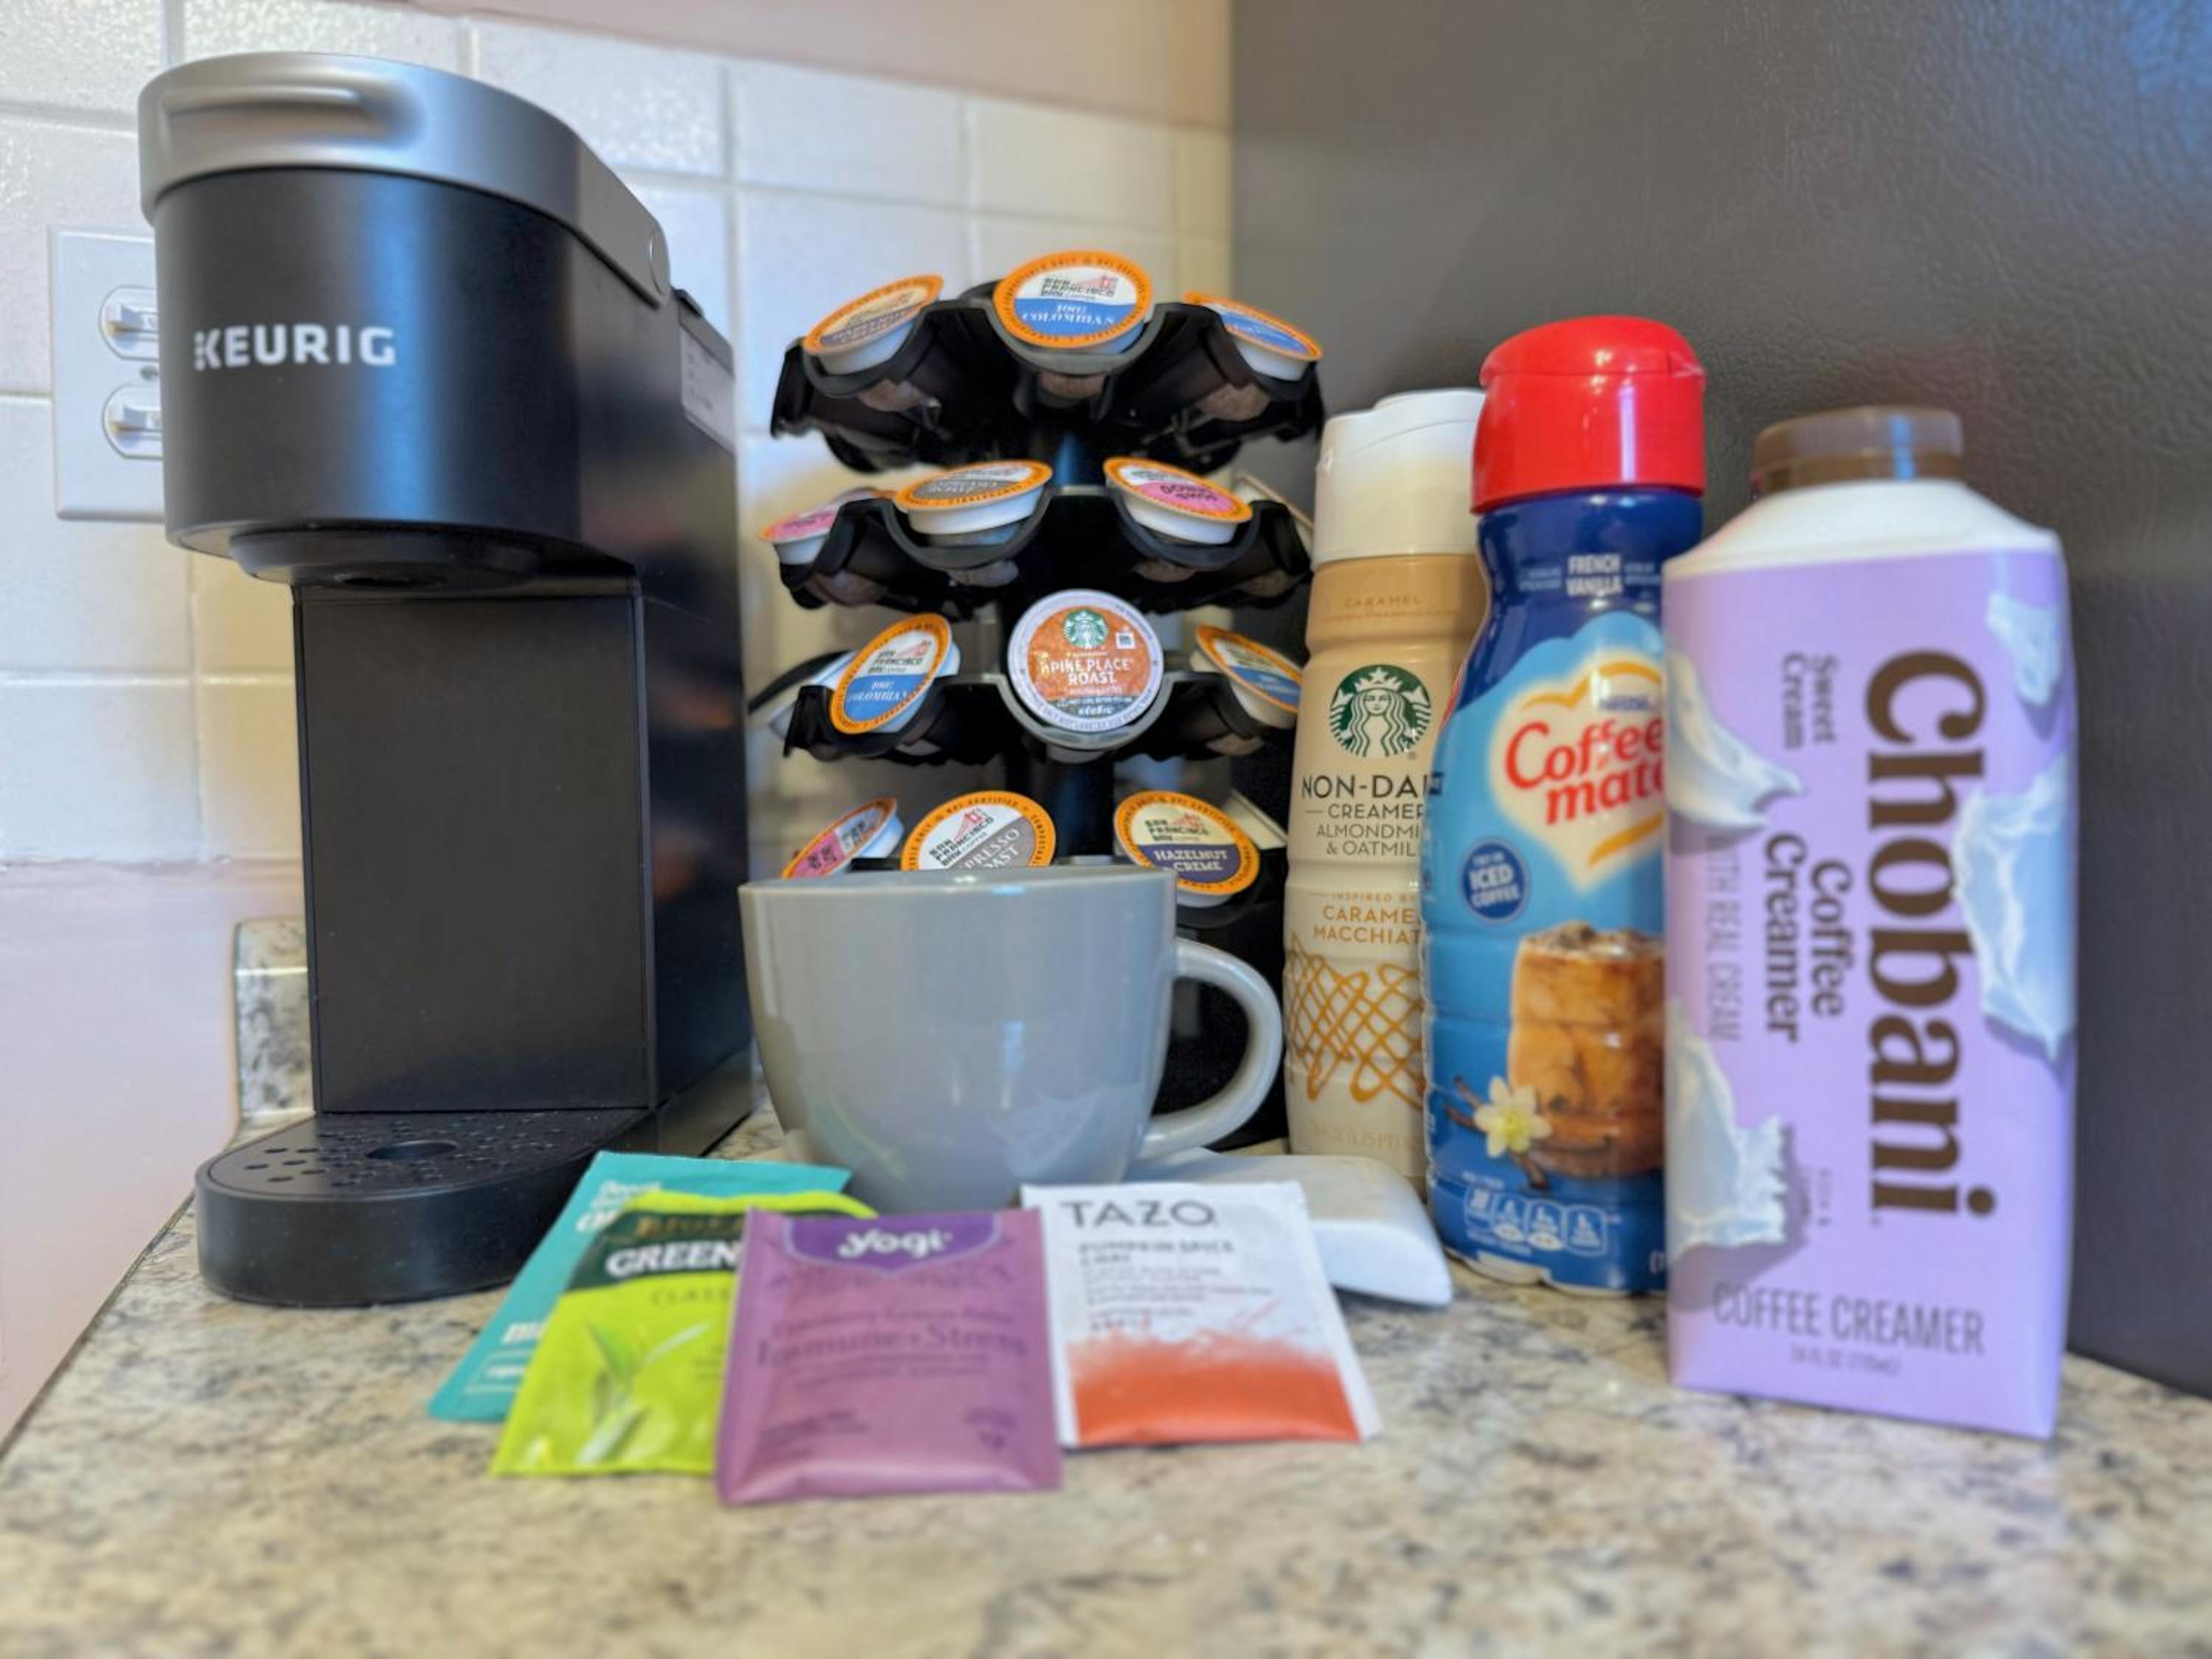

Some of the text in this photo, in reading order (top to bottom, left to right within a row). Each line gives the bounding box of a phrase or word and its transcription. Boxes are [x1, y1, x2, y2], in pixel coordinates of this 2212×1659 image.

[193, 323, 397, 371] KEURIG
[1568, 554, 1621, 574] FRENCH
[1344, 594, 1421, 608] CARAMEL
[1068, 672, 1117, 686] ROAST
[1086, 658, 1132, 672] PLACE
[1782, 653, 1806, 749] Cream
[1812, 653, 1837, 743] Sweet
[1505, 717, 1663, 790] Coffee
[1301, 773, 1428, 799] NON-DAI
[965, 827, 1020, 870] PRESSO
[1316, 824, 1420, 839] ALMONDMI
[1153, 849, 1228, 861] HAZELNUT
[1326, 841, 1417, 858] & OATMIL
[1332, 891, 1393, 903] INSPIRED
[1313, 922, 1421, 945] MACCHIAT
[1707, 900, 1741, 954] REAL
[1765, 833, 1806, 1043] Creamer
[1810, 859, 1853, 1018] Coffee
[1864, 649, 1997, 1217] Chobani
[1707, 961, 1741, 1042] CREAM
[1059, 1199, 1217, 1228] TAZO
[605, 1241, 740, 1278] GREEN
[838, 1228, 948, 1259] yogi
[1712, 1281, 1985, 1355] COFFEE CREAMER
